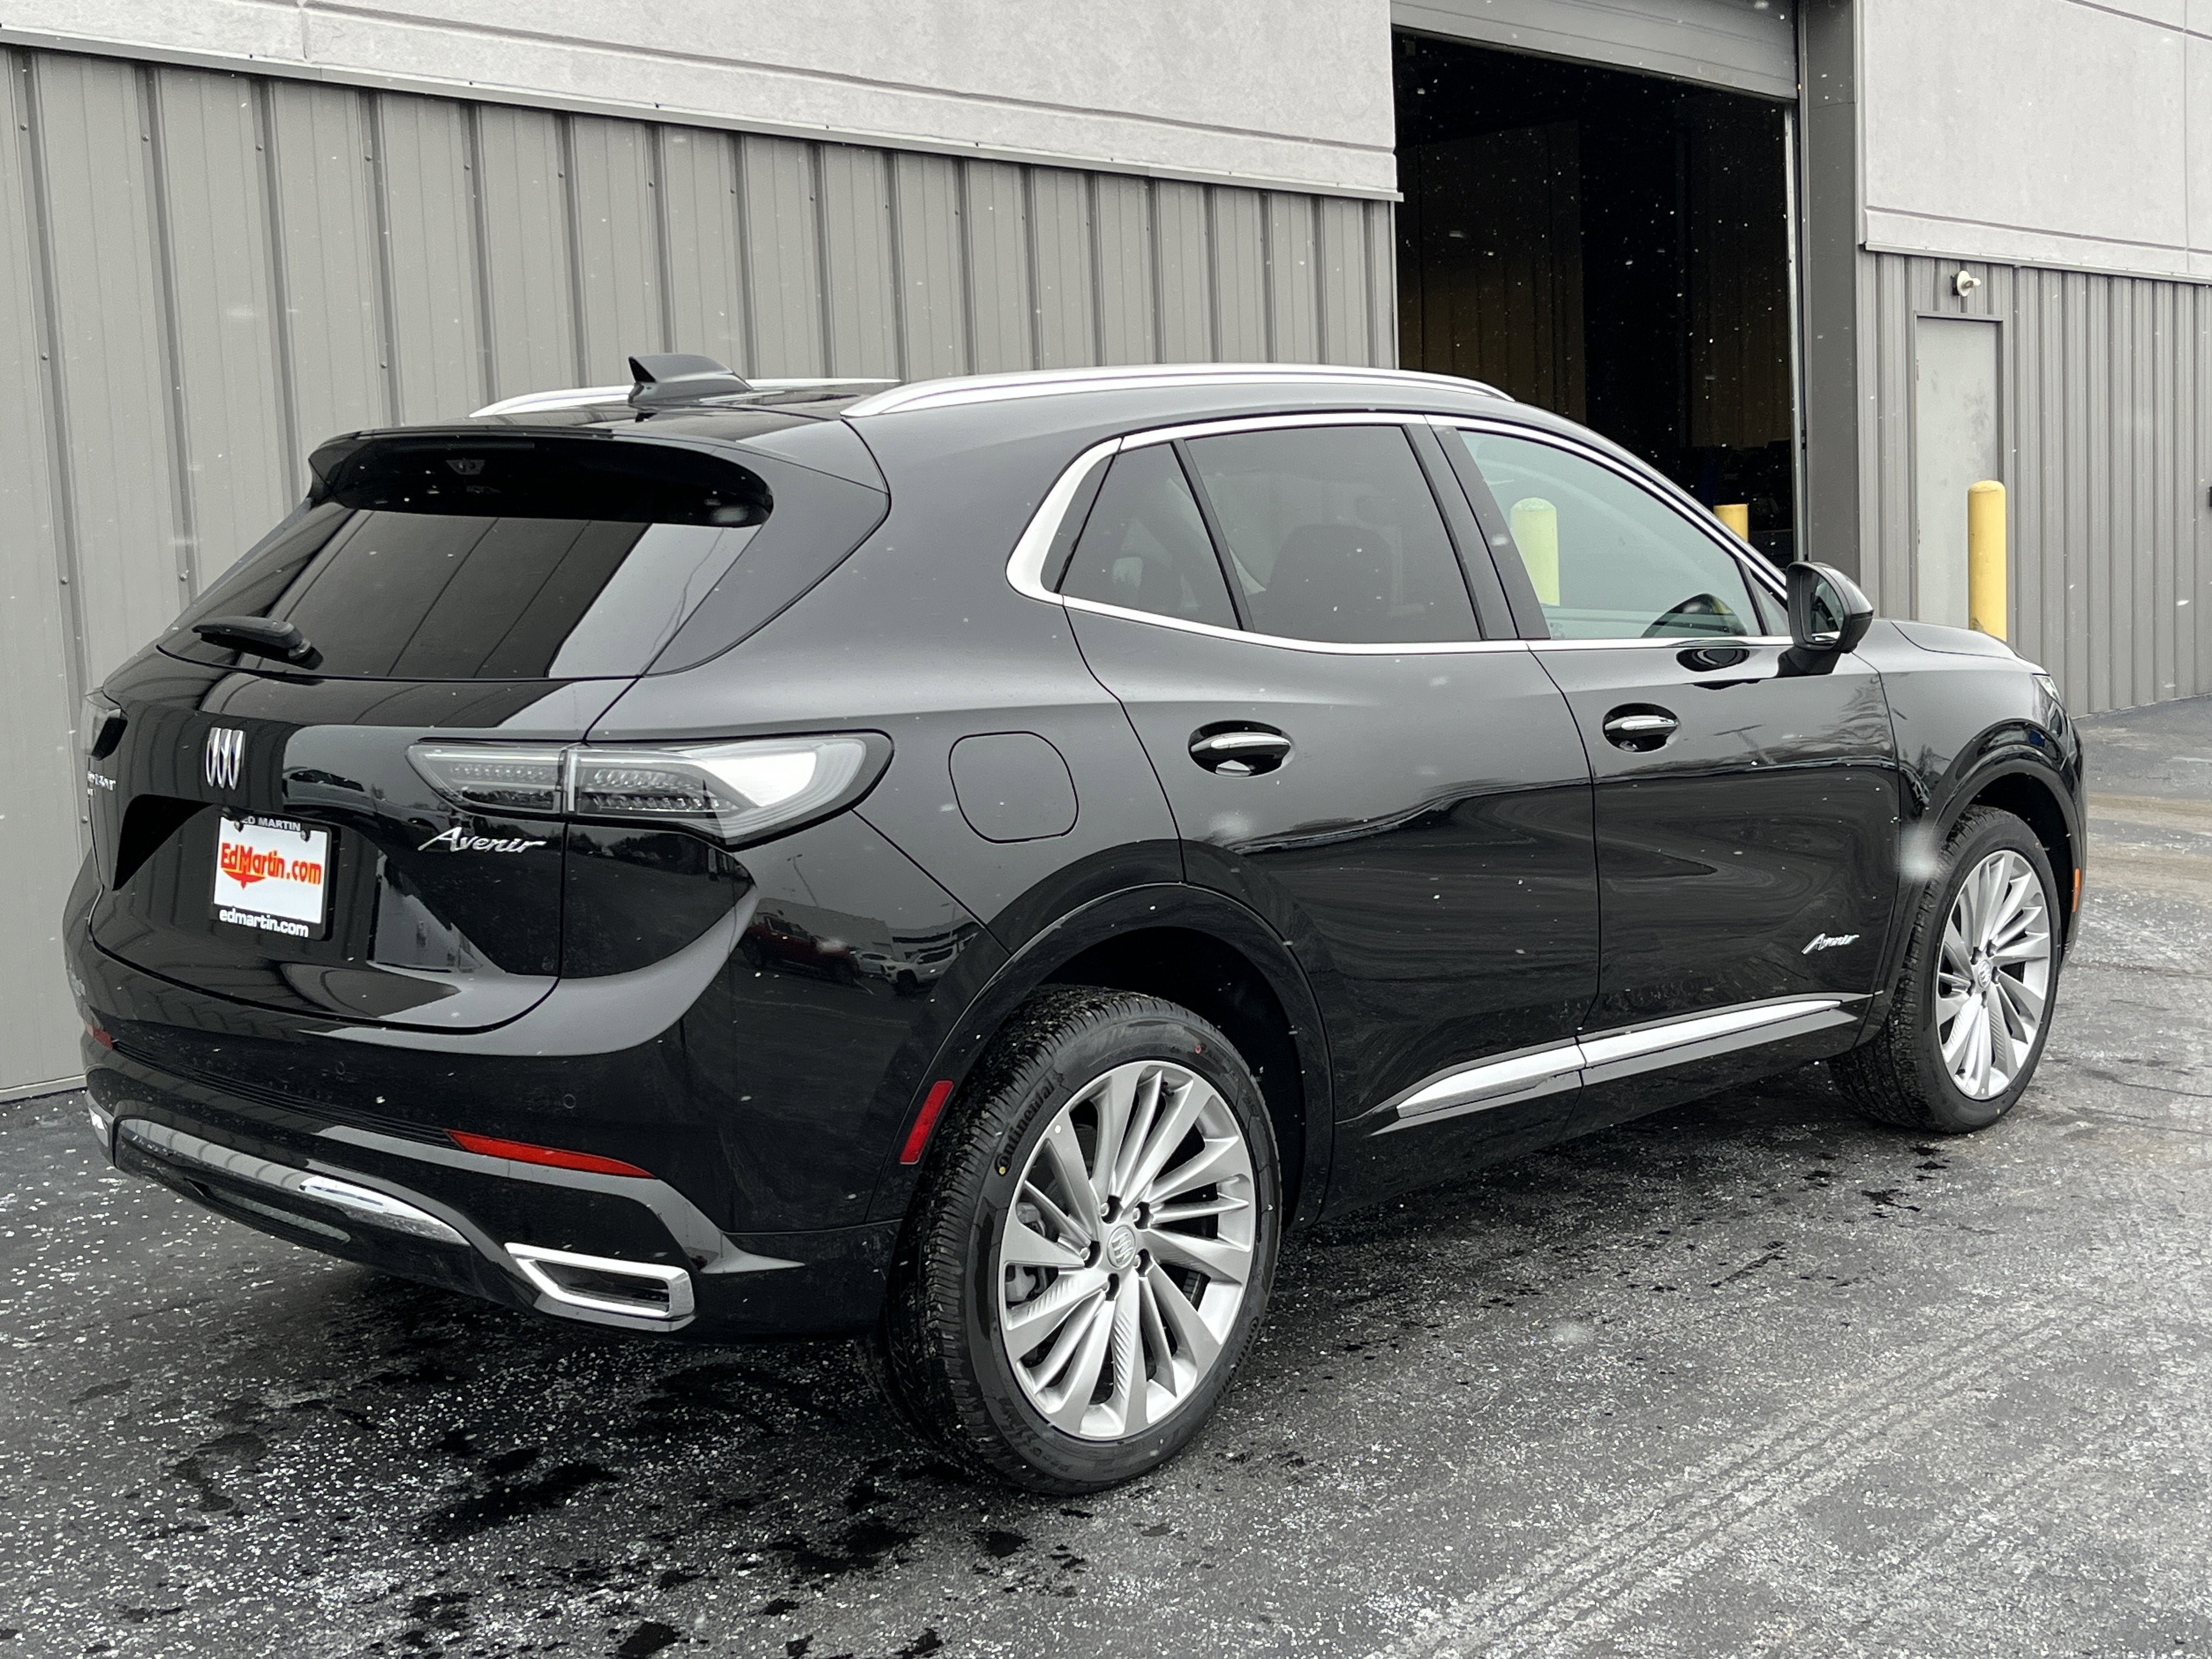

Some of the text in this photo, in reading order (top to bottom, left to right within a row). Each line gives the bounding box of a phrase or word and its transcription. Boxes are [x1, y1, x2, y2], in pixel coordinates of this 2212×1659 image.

[258, 817, 301, 832] MARTIN
[417, 826, 547, 853] Avenir
[221, 843, 322, 884] EdMartin.com
[219, 908, 308, 938] edmartin.com
